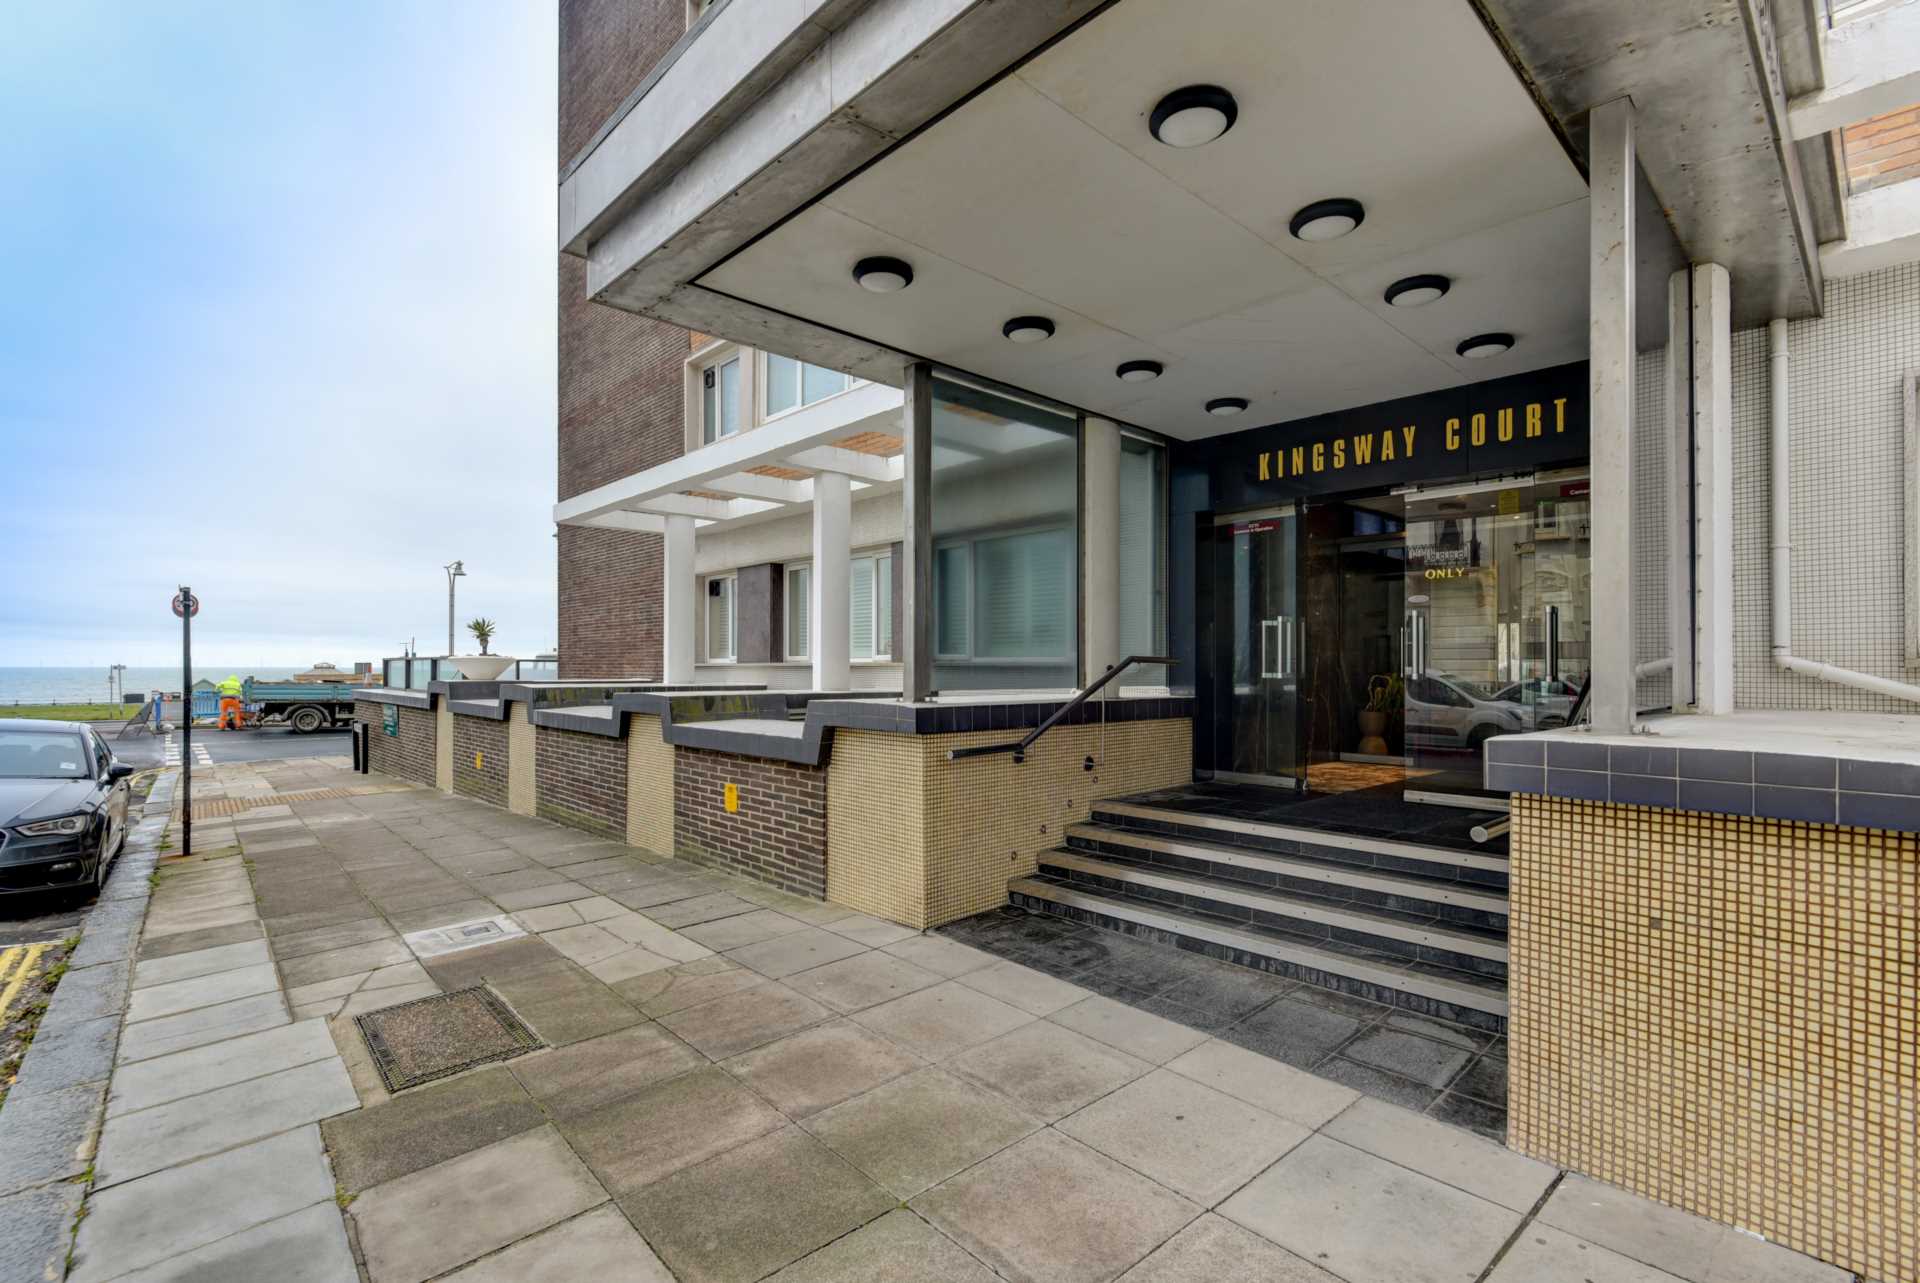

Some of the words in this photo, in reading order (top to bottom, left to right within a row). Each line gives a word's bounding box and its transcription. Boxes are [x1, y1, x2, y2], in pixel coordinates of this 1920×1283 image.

[1259, 425, 1416, 481] KINGSWAY
[1445, 398, 1567, 451] COURT
[1424, 567, 1465, 580] ONLY
